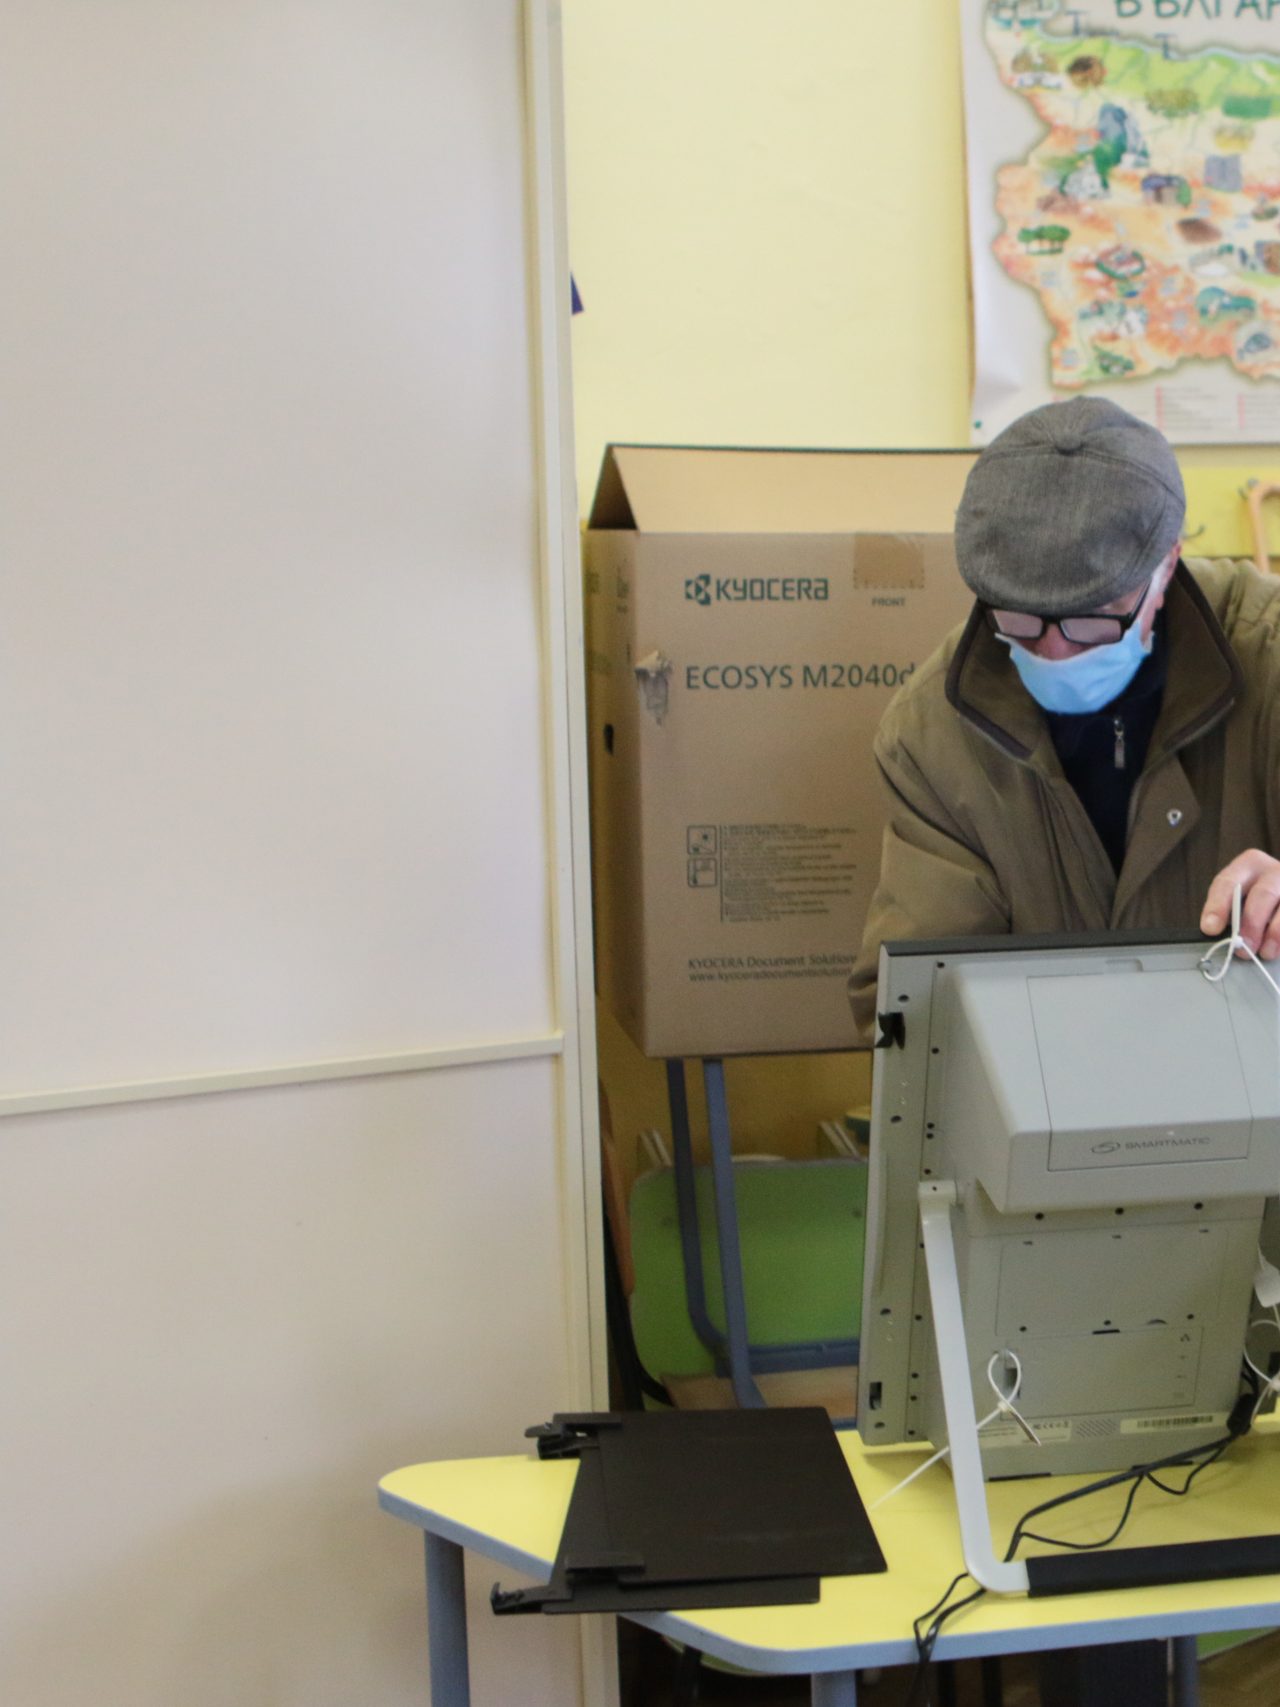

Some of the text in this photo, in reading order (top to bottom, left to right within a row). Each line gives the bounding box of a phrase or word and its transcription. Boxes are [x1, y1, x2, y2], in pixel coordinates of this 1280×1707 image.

[871, 597, 906, 607] FRONT
[686, 665, 793, 690] ECOSYS
[688, 958, 745, 969] KYOCERA
[747, 956, 805, 968] Document
[1125, 1137, 1210, 1149] SMARTMATIC
